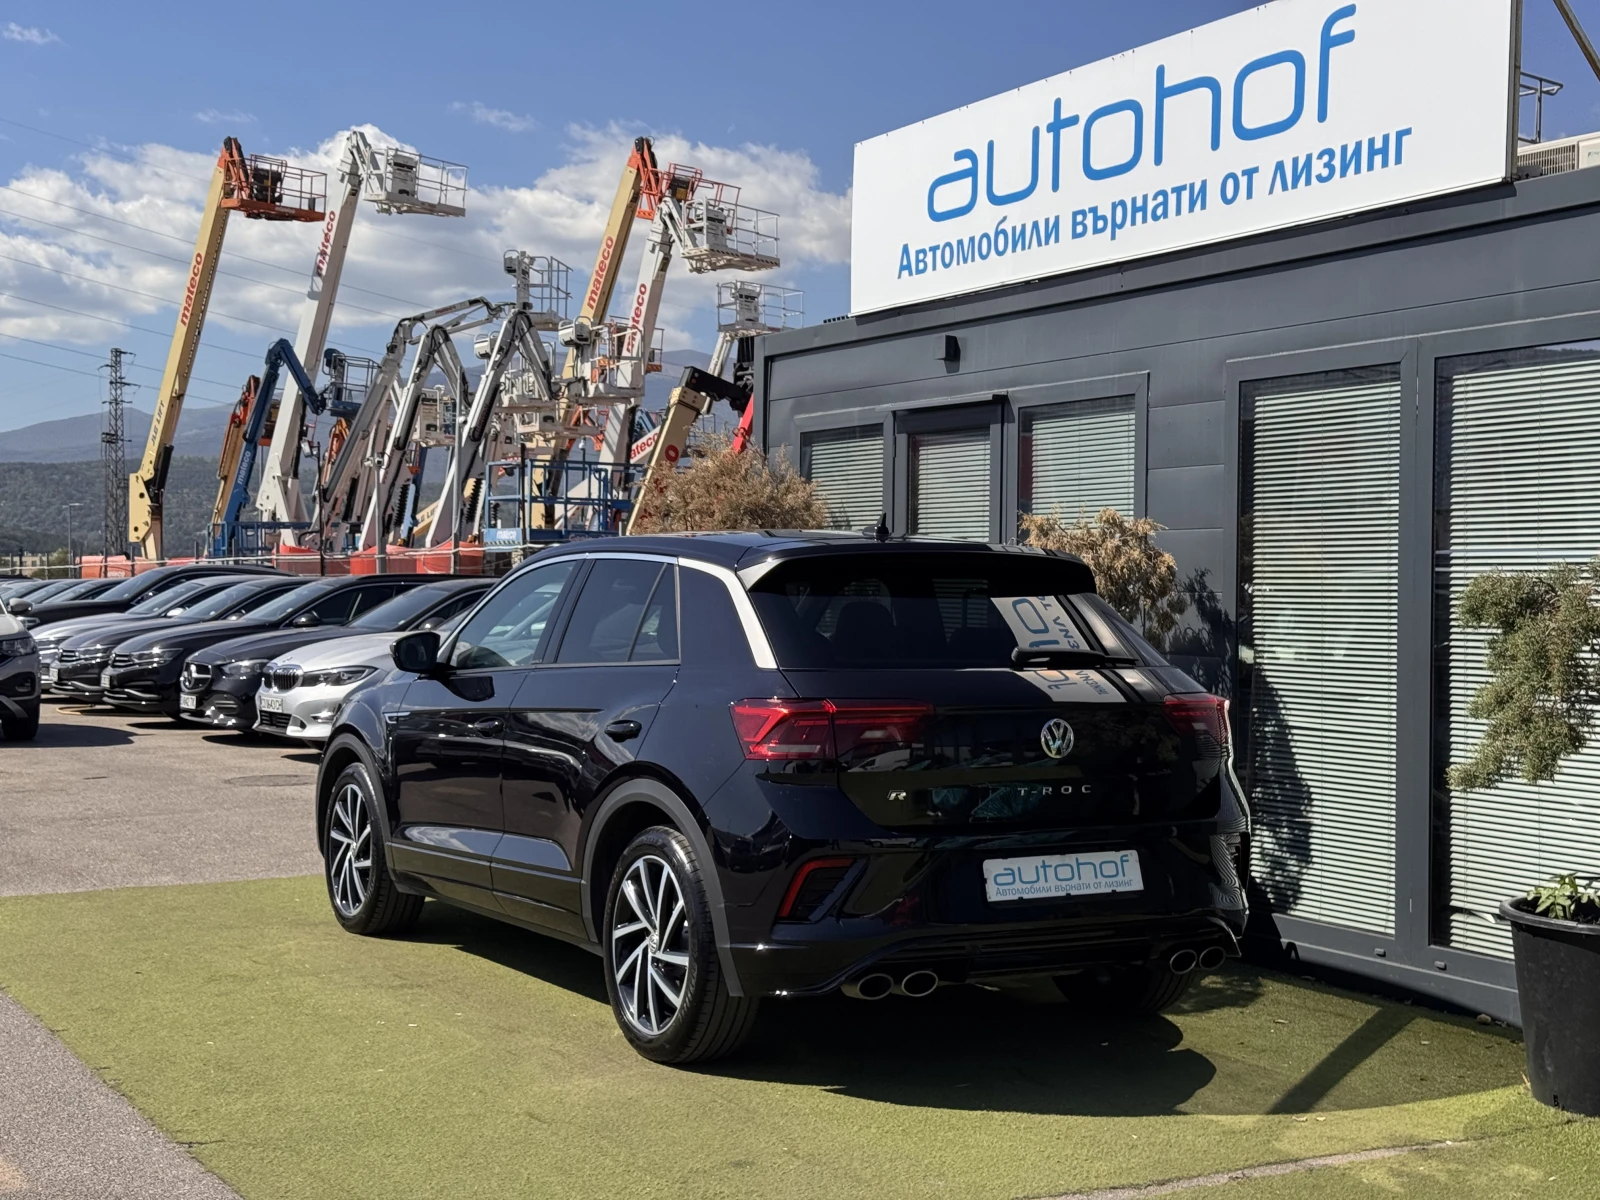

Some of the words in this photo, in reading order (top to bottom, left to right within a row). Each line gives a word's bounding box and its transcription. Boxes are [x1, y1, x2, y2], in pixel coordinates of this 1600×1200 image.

[928, 4, 1357, 222] autohof
[898, 216, 1060, 280] Автомобили
[1071, 180, 1209, 240] върнати
[1219, 164, 1259, 206] от
[1268, 127, 1412, 195] лизинг
[180, 252, 203, 327] mateco
[587, 236, 614, 310] mateco
[237, 450, 251, 485] mateco
[993, 853, 1130, 888] autohof
[995, 884, 1052, 897] Автомобили
[1054, 882, 1091, 894] върнати
[1093, 880, 1102, 890] от
[1104, 878, 1134, 889] лизинг
